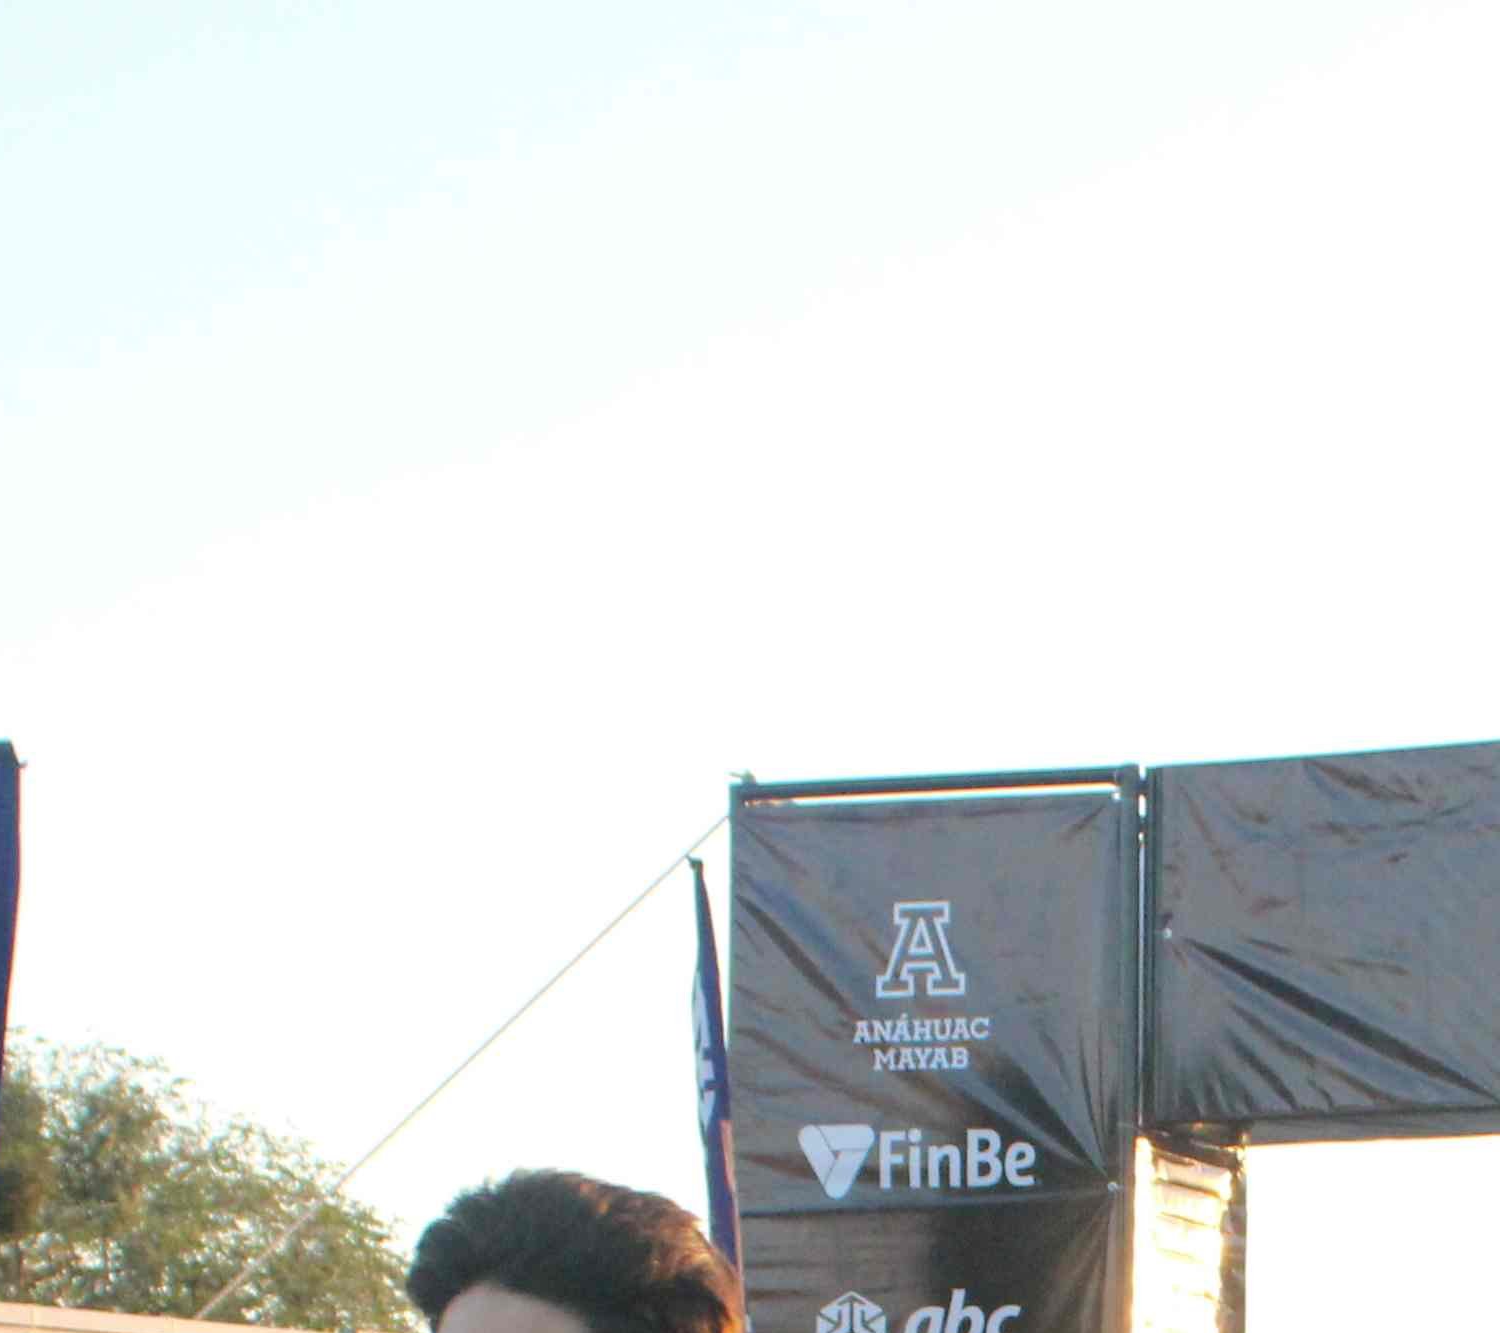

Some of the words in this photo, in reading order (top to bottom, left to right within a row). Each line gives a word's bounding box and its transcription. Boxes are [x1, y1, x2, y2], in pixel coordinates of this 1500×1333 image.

[852, 1014, 991, 1046] ANÁHUAC
[873, 1046, 971, 1072] MAYAB
[878, 1127, 1037, 1190] FinBe
